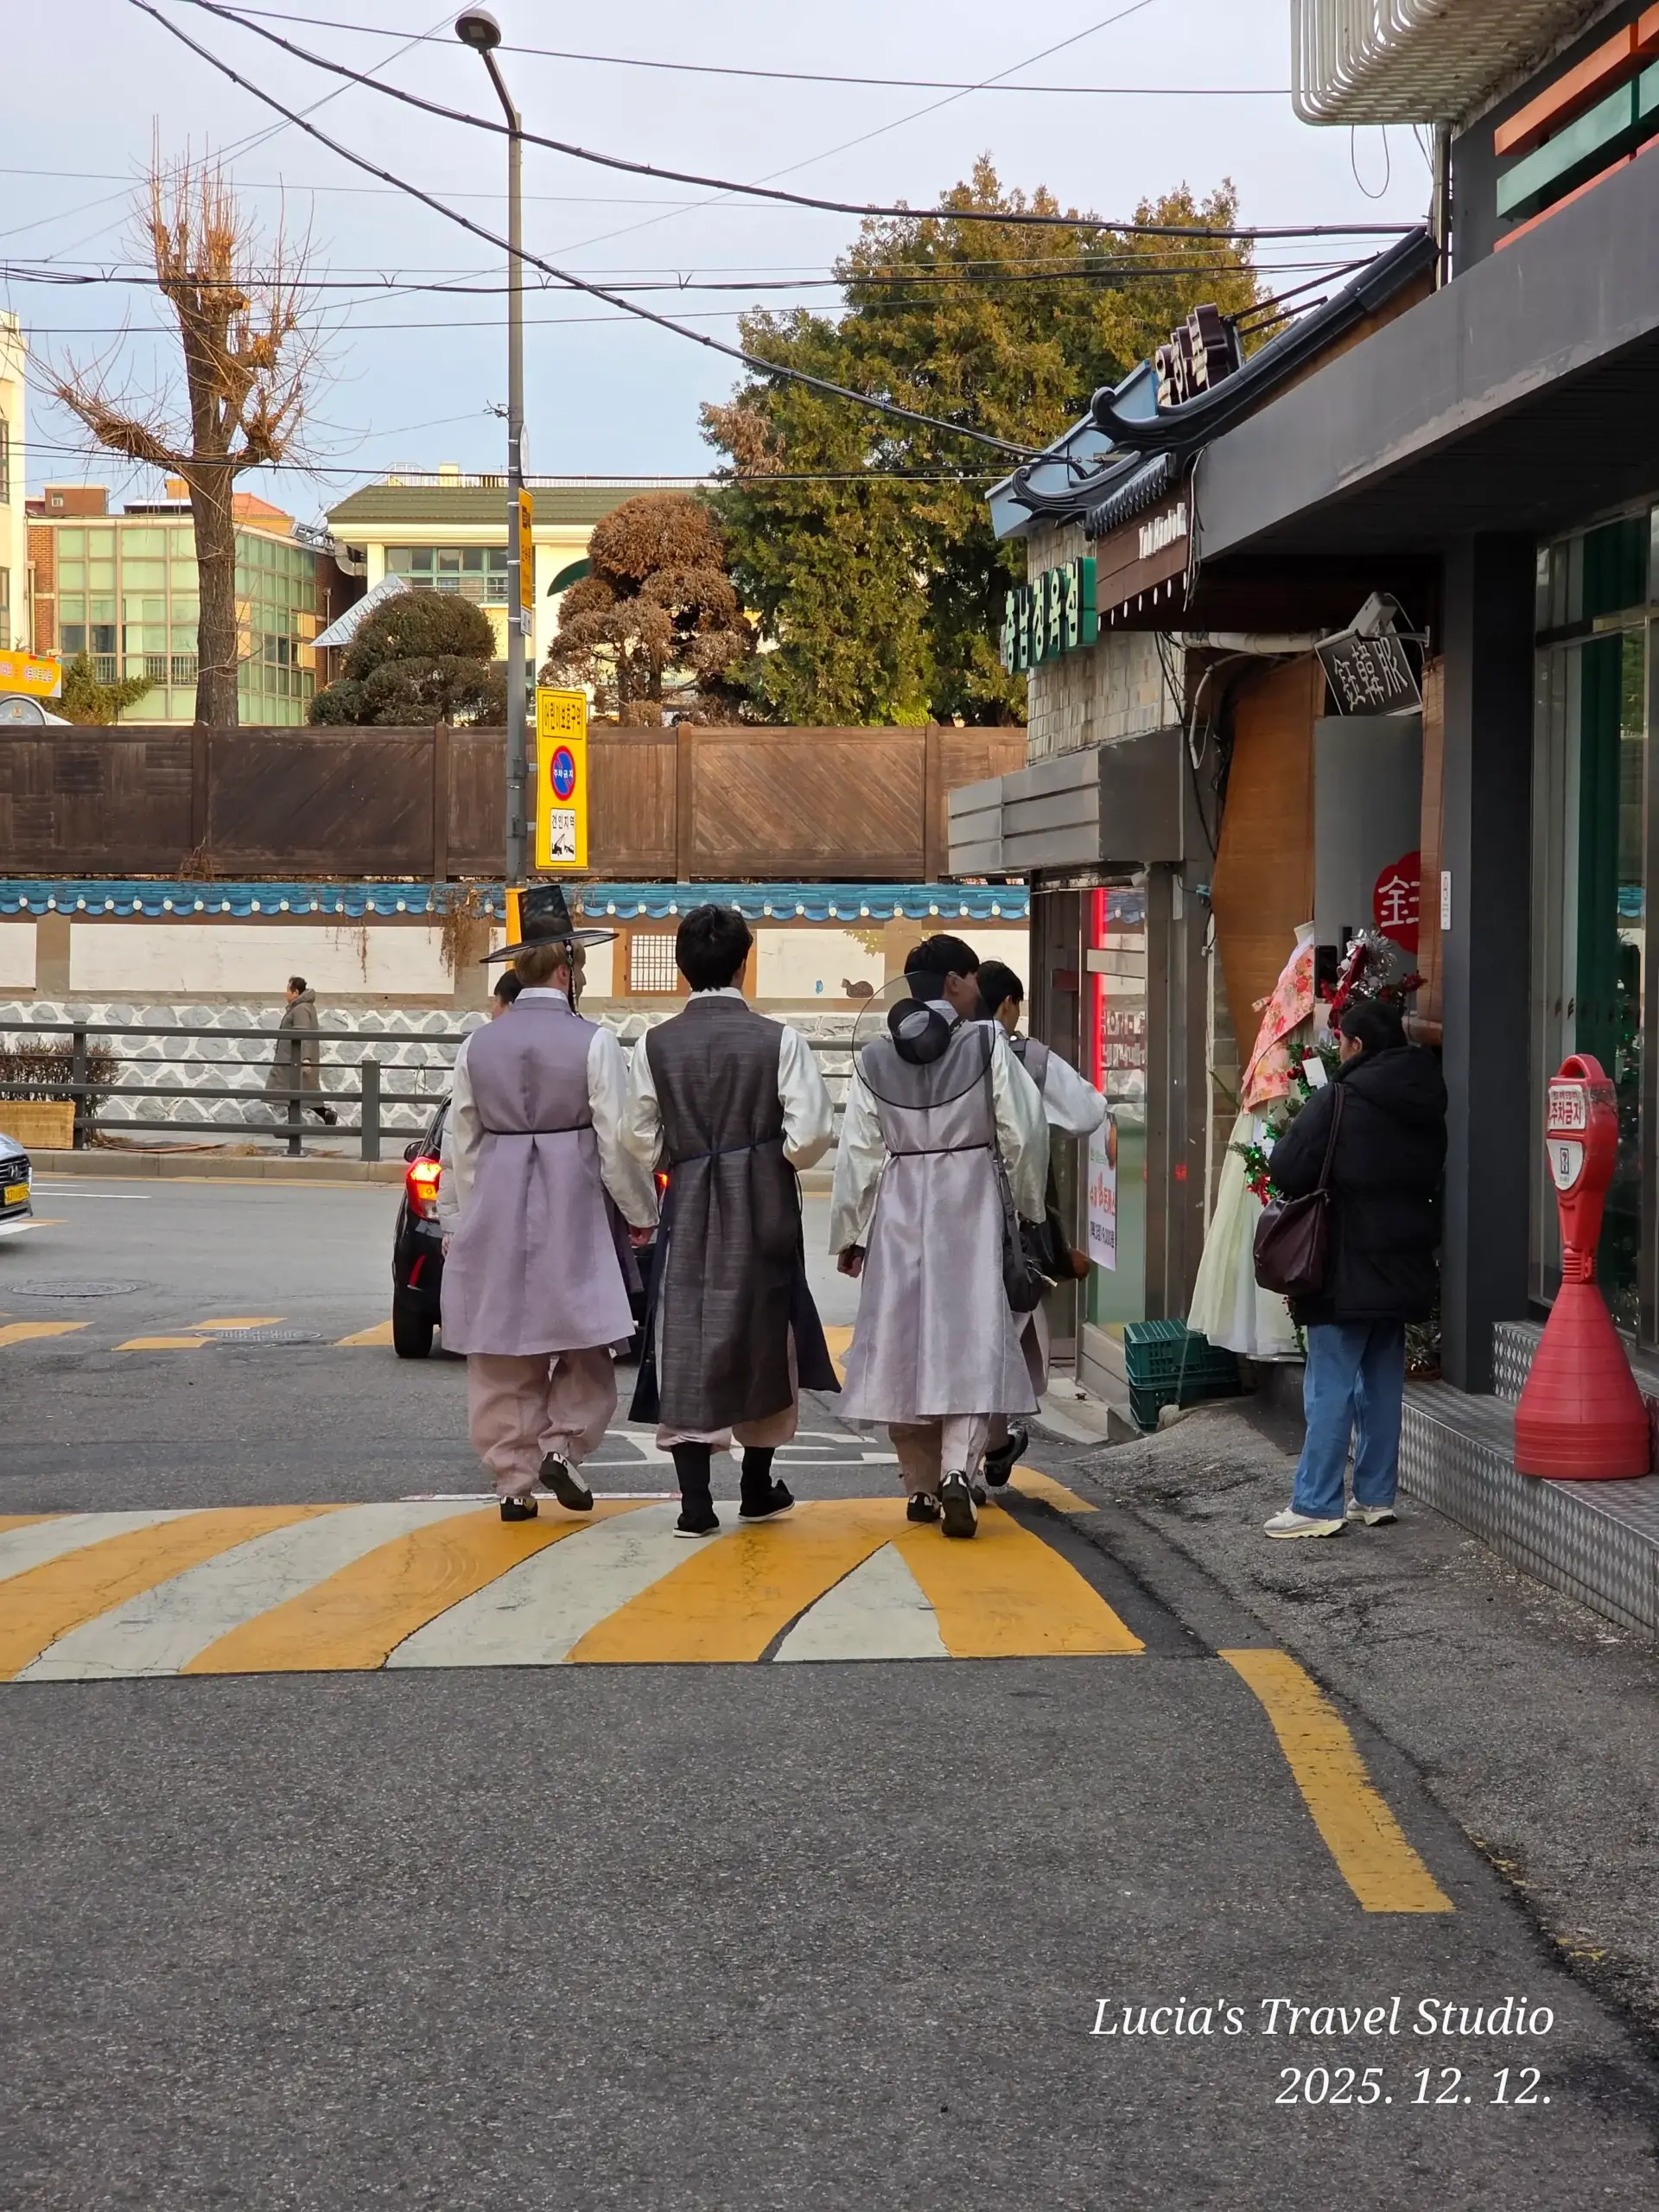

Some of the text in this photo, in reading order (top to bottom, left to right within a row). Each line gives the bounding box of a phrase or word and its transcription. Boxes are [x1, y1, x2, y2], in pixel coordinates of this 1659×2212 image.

[1005, 557, 1082, 675] 충남정육점
[544, 701, 582, 734] 어린이보호구역
[553, 768, 574, 779] 주차금지
[551, 815, 575, 830] 견인지역
[1552, 1101, 1582, 1125] 주차금지
